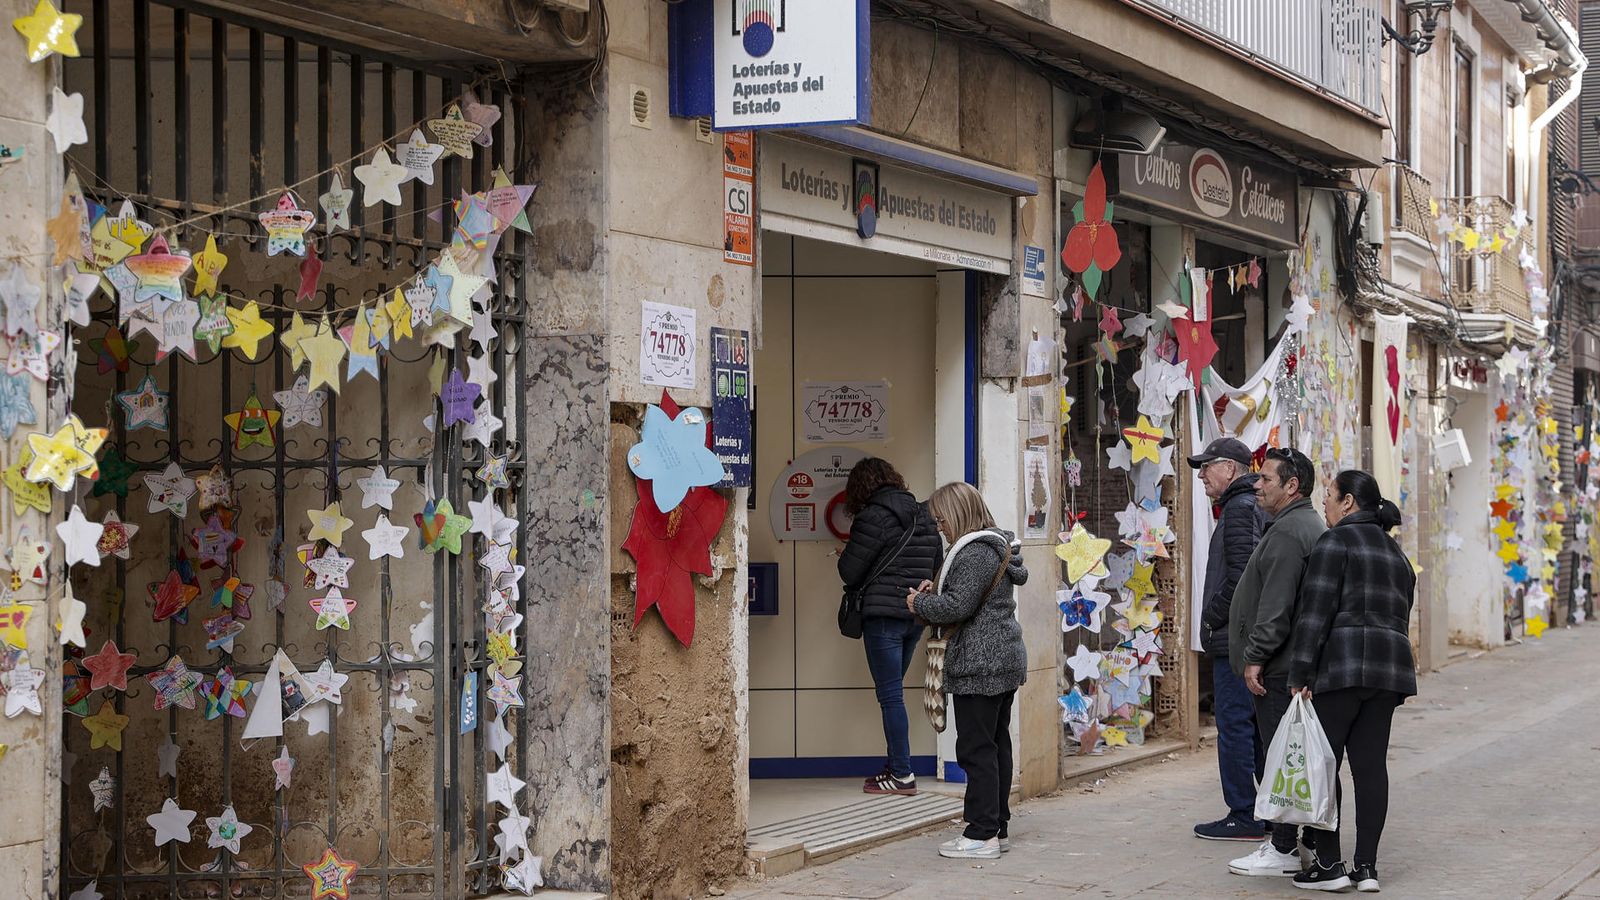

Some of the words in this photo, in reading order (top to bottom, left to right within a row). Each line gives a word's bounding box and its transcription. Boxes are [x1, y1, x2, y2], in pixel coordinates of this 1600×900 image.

[732, 60, 790, 79] Loterías
[793, 62, 802, 78] y
[733, 79, 798, 100] Apuestas
[802, 75, 824, 93] del
[733, 97, 781, 115] Estado
[1134, 146, 1181, 191] Centros
[1239, 165, 1285, 225] Estéticos
[728, 187, 749, 215] CSI
[781, 162, 838, 201] Loterías
[842, 183, 850, 211] y
[879, 186, 936, 223] Apuestas
[938, 201, 956, 227] del
[958, 204, 996, 236] Estado
[728, 214, 749, 226] ALARMA
[661, 322, 679, 331] PREMIO
[650, 330, 686, 357] 74778
[817, 401, 873, 419] 74778
[715, 435, 738, 447] Loterías
[737, 438, 743, 450] y
[740, 453, 750, 464] del
[792, 475, 808, 484] +18
